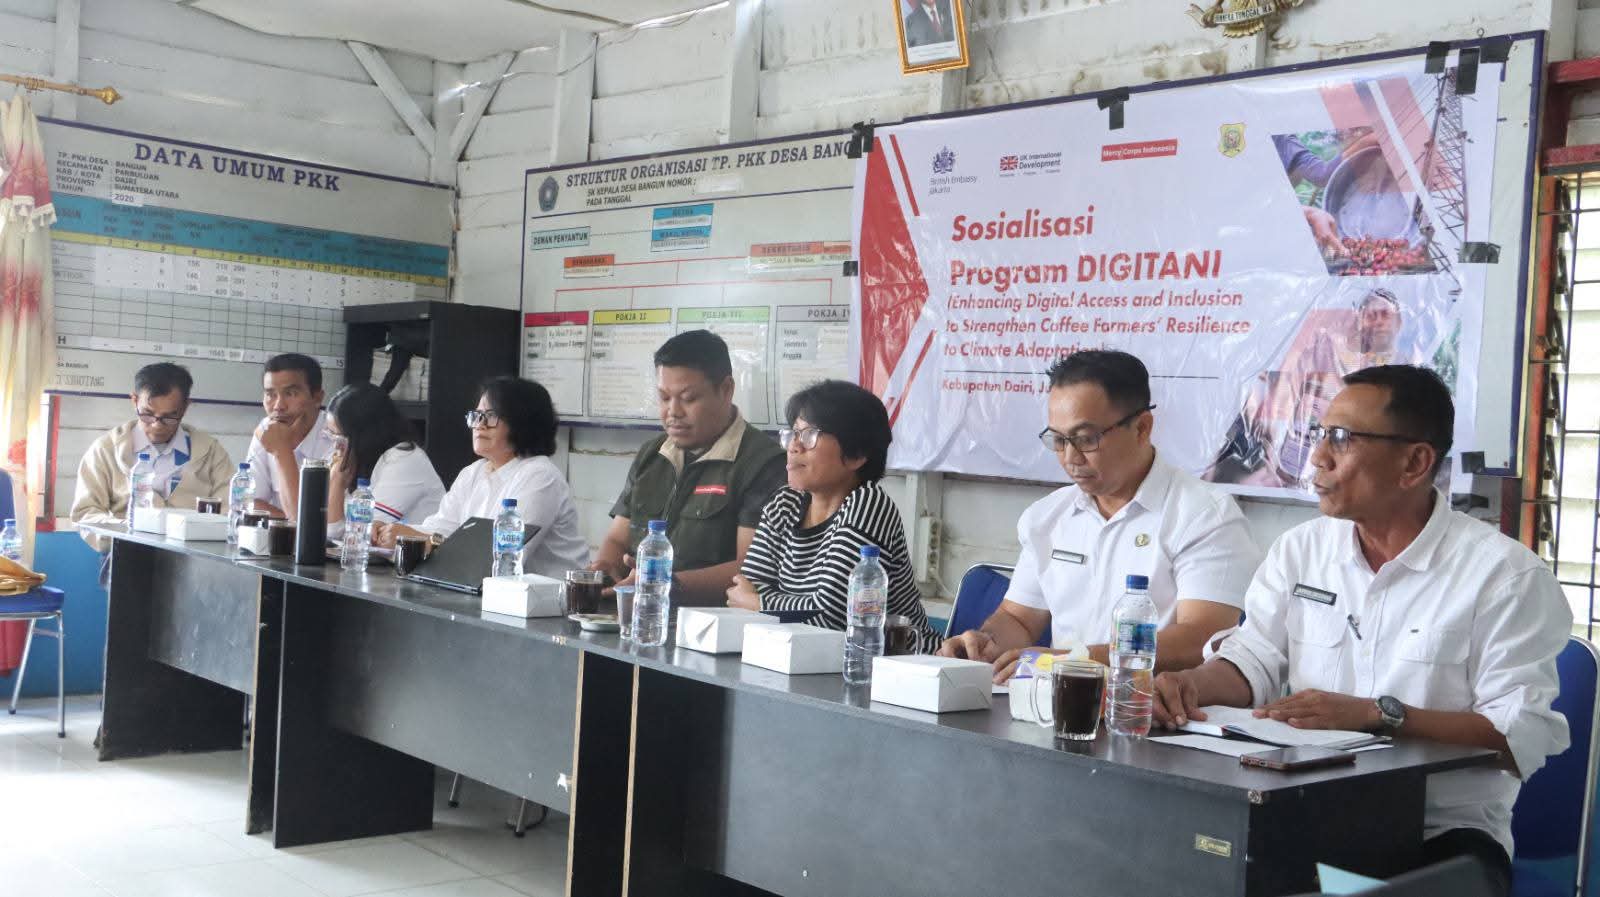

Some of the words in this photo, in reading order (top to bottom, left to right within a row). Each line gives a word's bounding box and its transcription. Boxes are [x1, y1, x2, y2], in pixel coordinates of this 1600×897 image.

[1029, 151, 1062, 160] International
[1102, 149, 1121, 160] Mercy
[1122, 147, 1142, 158] Corps
[1144, 144, 1176, 154] Indonesia
[56, 160, 104, 172] KECAMATAN
[89, 156, 109, 165] DESA
[116, 160, 147, 171] BANGUN
[1019, 159, 1061, 170] Development
[135, 143, 203, 170] DATA
[213, 156, 285, 182] UMUM
[294, 170, 340, 191] PKK
[566, 171, 627, 188] STRUKTUR
[631, 158, 707, 182] ORGANISASI
[711, 156, 732, 171] TP.
[736, 153, 766, 169] PKK
[770, 147, 808, 166] DESA
[80, 170, 101, 180] KOTA
[114, 176, 138, 185] DAIRI
[57, 183, 84, 192] TAHUN
[114, 184, 154, 195] SUMATERA
[156, 189, 180, 199] UTARA
[597, 186, 619, 196] KEPALA
[621, 184, 636, 194] DESA
[638, 180, 665, 192] BANGUN
[114, 193, 134, 202] 2020
[604, 195, 632, 206] TANGGAL
[952, 204, 1094, 242] Sosialisasi
[553, 230, 588, 242] PENYANTUN
[950, 260, 1067, 293] Program
[1078, 249, 1222, 282] DIGITANI
[1026, 291, 1074, 312] Digital
[1078, 293, 1128, 307] Access
[1132, 290, 1162, 306] and
[1168, 288, 1242, 306] Inclusion
[808, 308, 837, 318] POKJA
[946, 319, 958, 332] to
[964, 319, 1036, 337] Strengthen
[1041, 316, 1088, 334] Coffee
[1167, 317, 1250, 334] Resilience
[944, 344, 957, 356] to
[961, 342, 1011, 356] Climate
[942, 379, 1002, 394] Kabupaten
[1004, 380, 1035, 395] Dairi,
